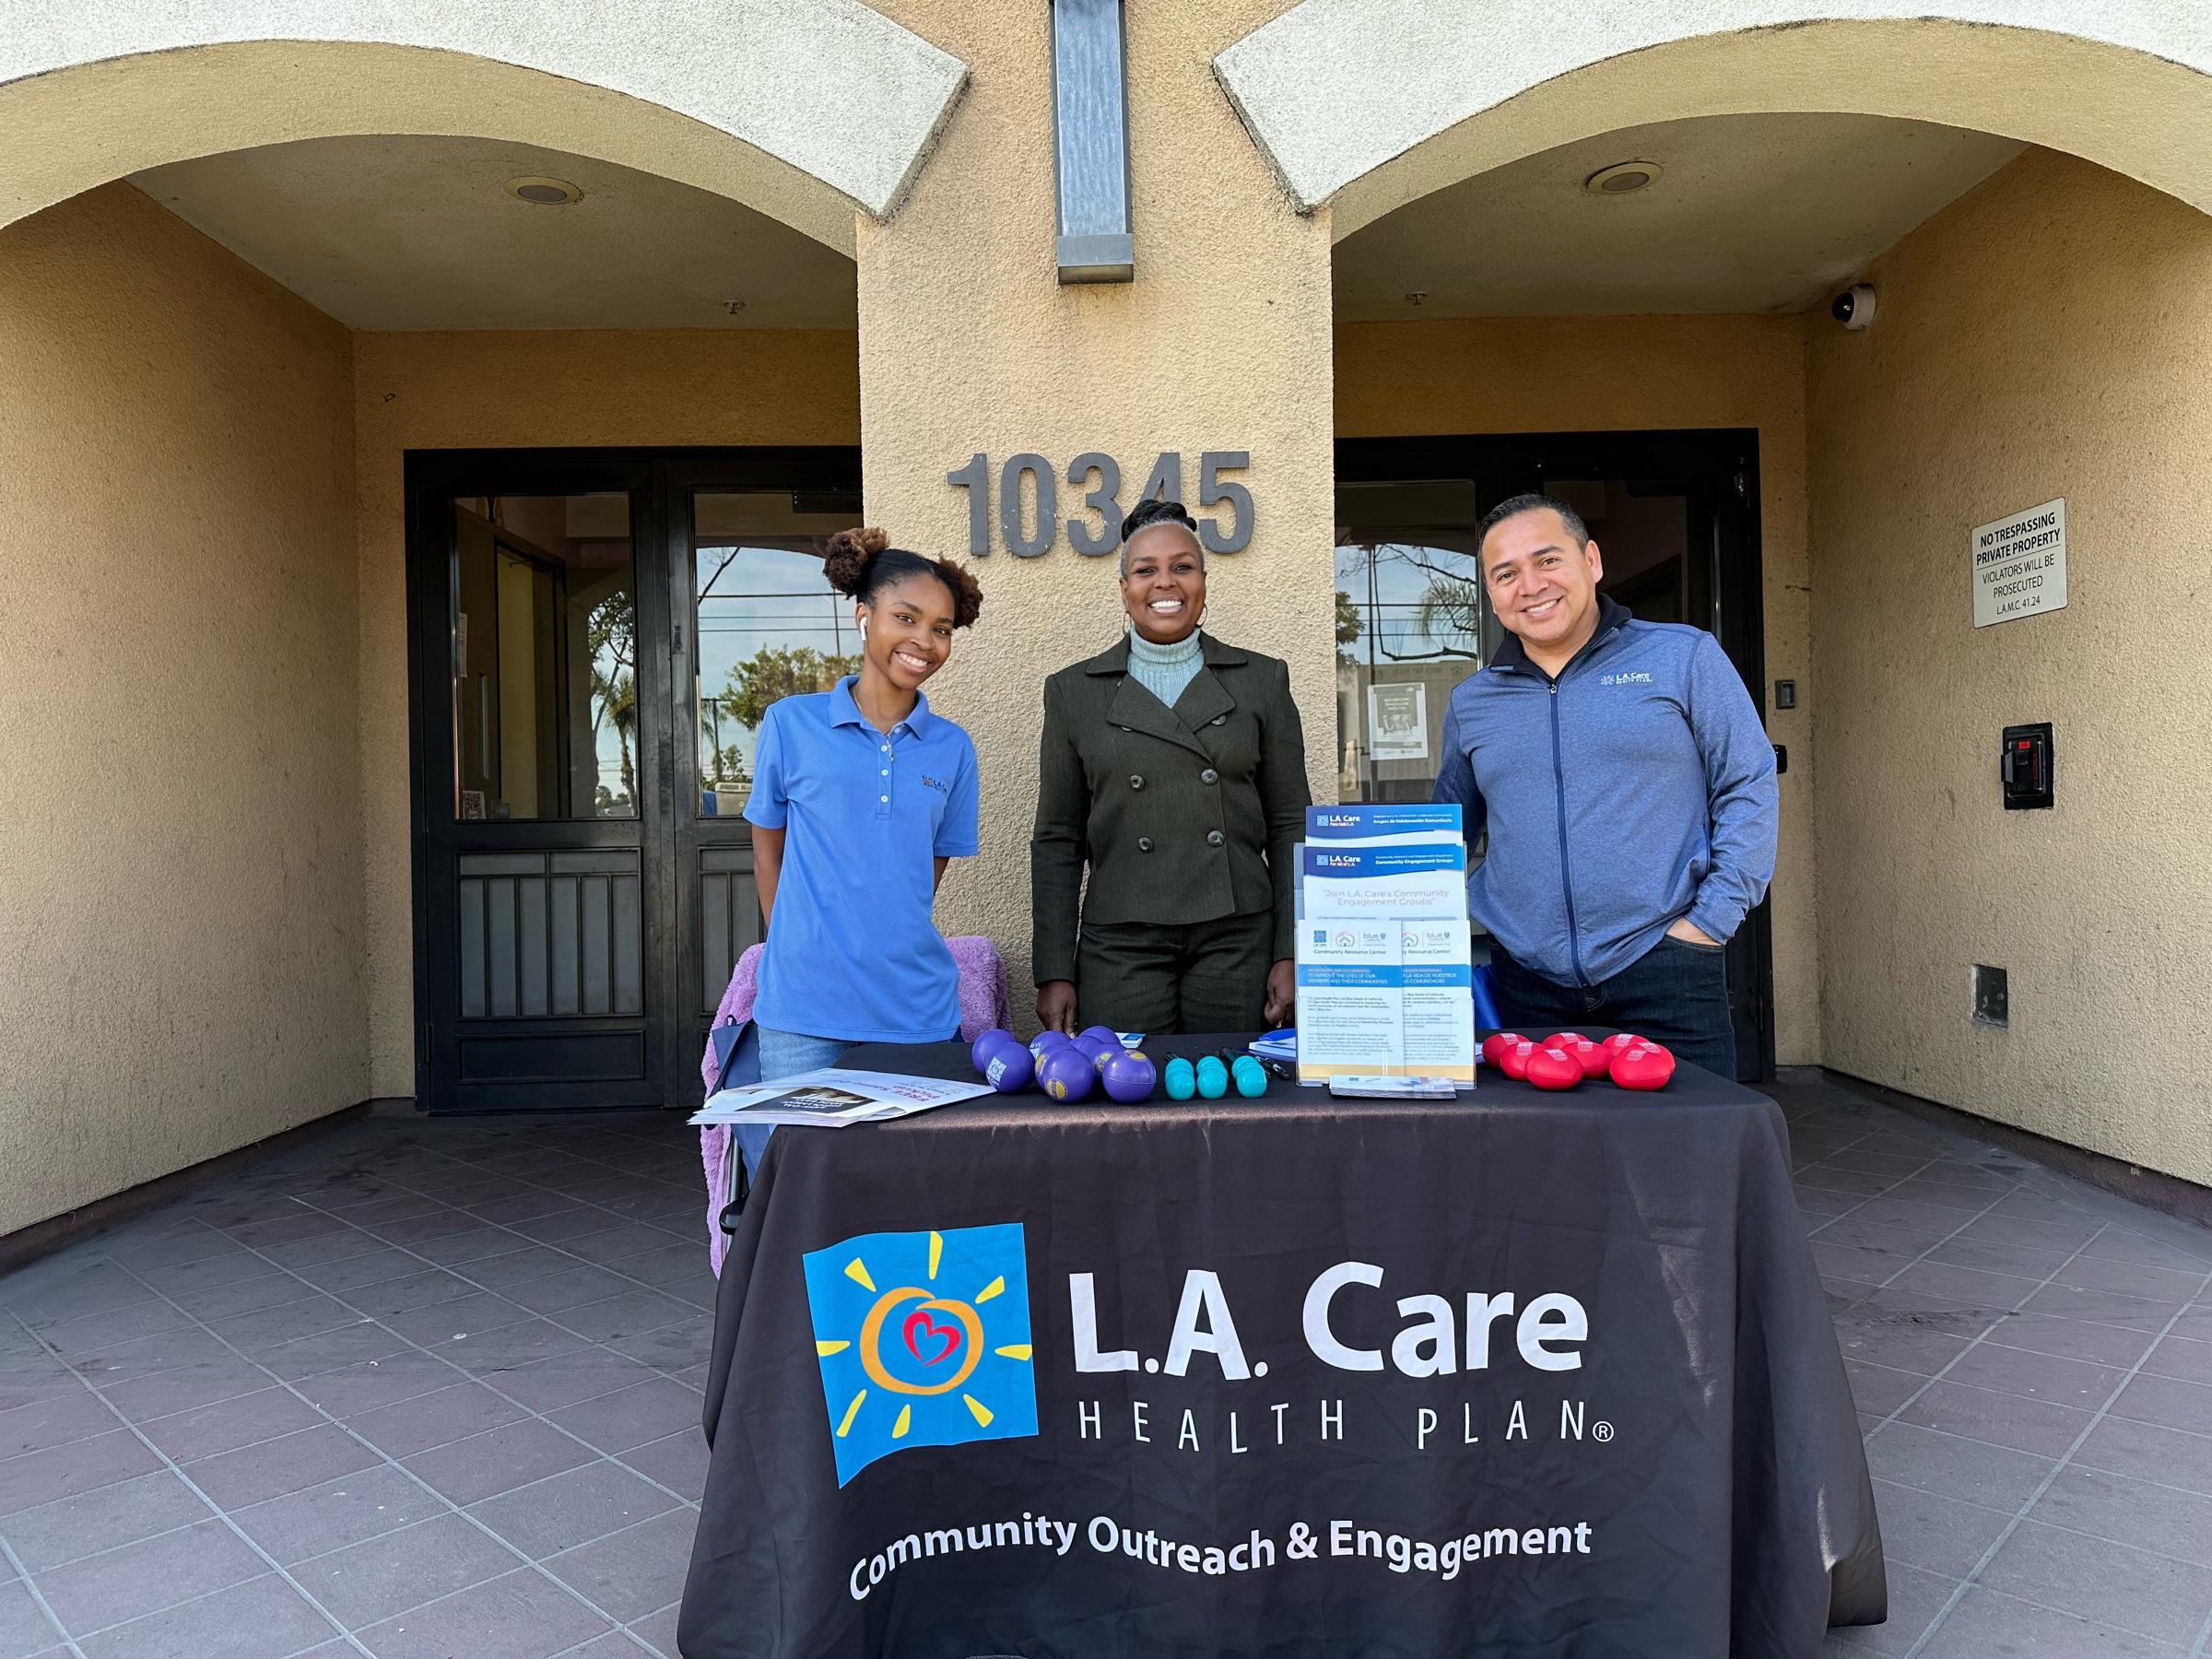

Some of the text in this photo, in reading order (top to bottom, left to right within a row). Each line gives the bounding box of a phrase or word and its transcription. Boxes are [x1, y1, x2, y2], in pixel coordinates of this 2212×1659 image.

[1980, 512, 2055, 547] NO TRESPASSING
[1976, 528, 2061, 566] PRIVATE PROPERTY
[1983, 554, 2054, 584] VIOLATORS WILL BE
[1994, 575, 2043, 598] PROSECUTED
[2022, 595, 2041, 609] 41.24
[1343, 814, 1360, 822] Care
[1337, 898, 1397, 908] Engagement
[1364, 889, 1392, 898] Care's
[1394, 889, 1450, 899] Community
[1068, 1260, 1589, 1382] L.A. Care
[1078, 1398, 1346, 1454] HEALTH
[846, 1512, 1593, 1602] Community Outreach & Engagement
